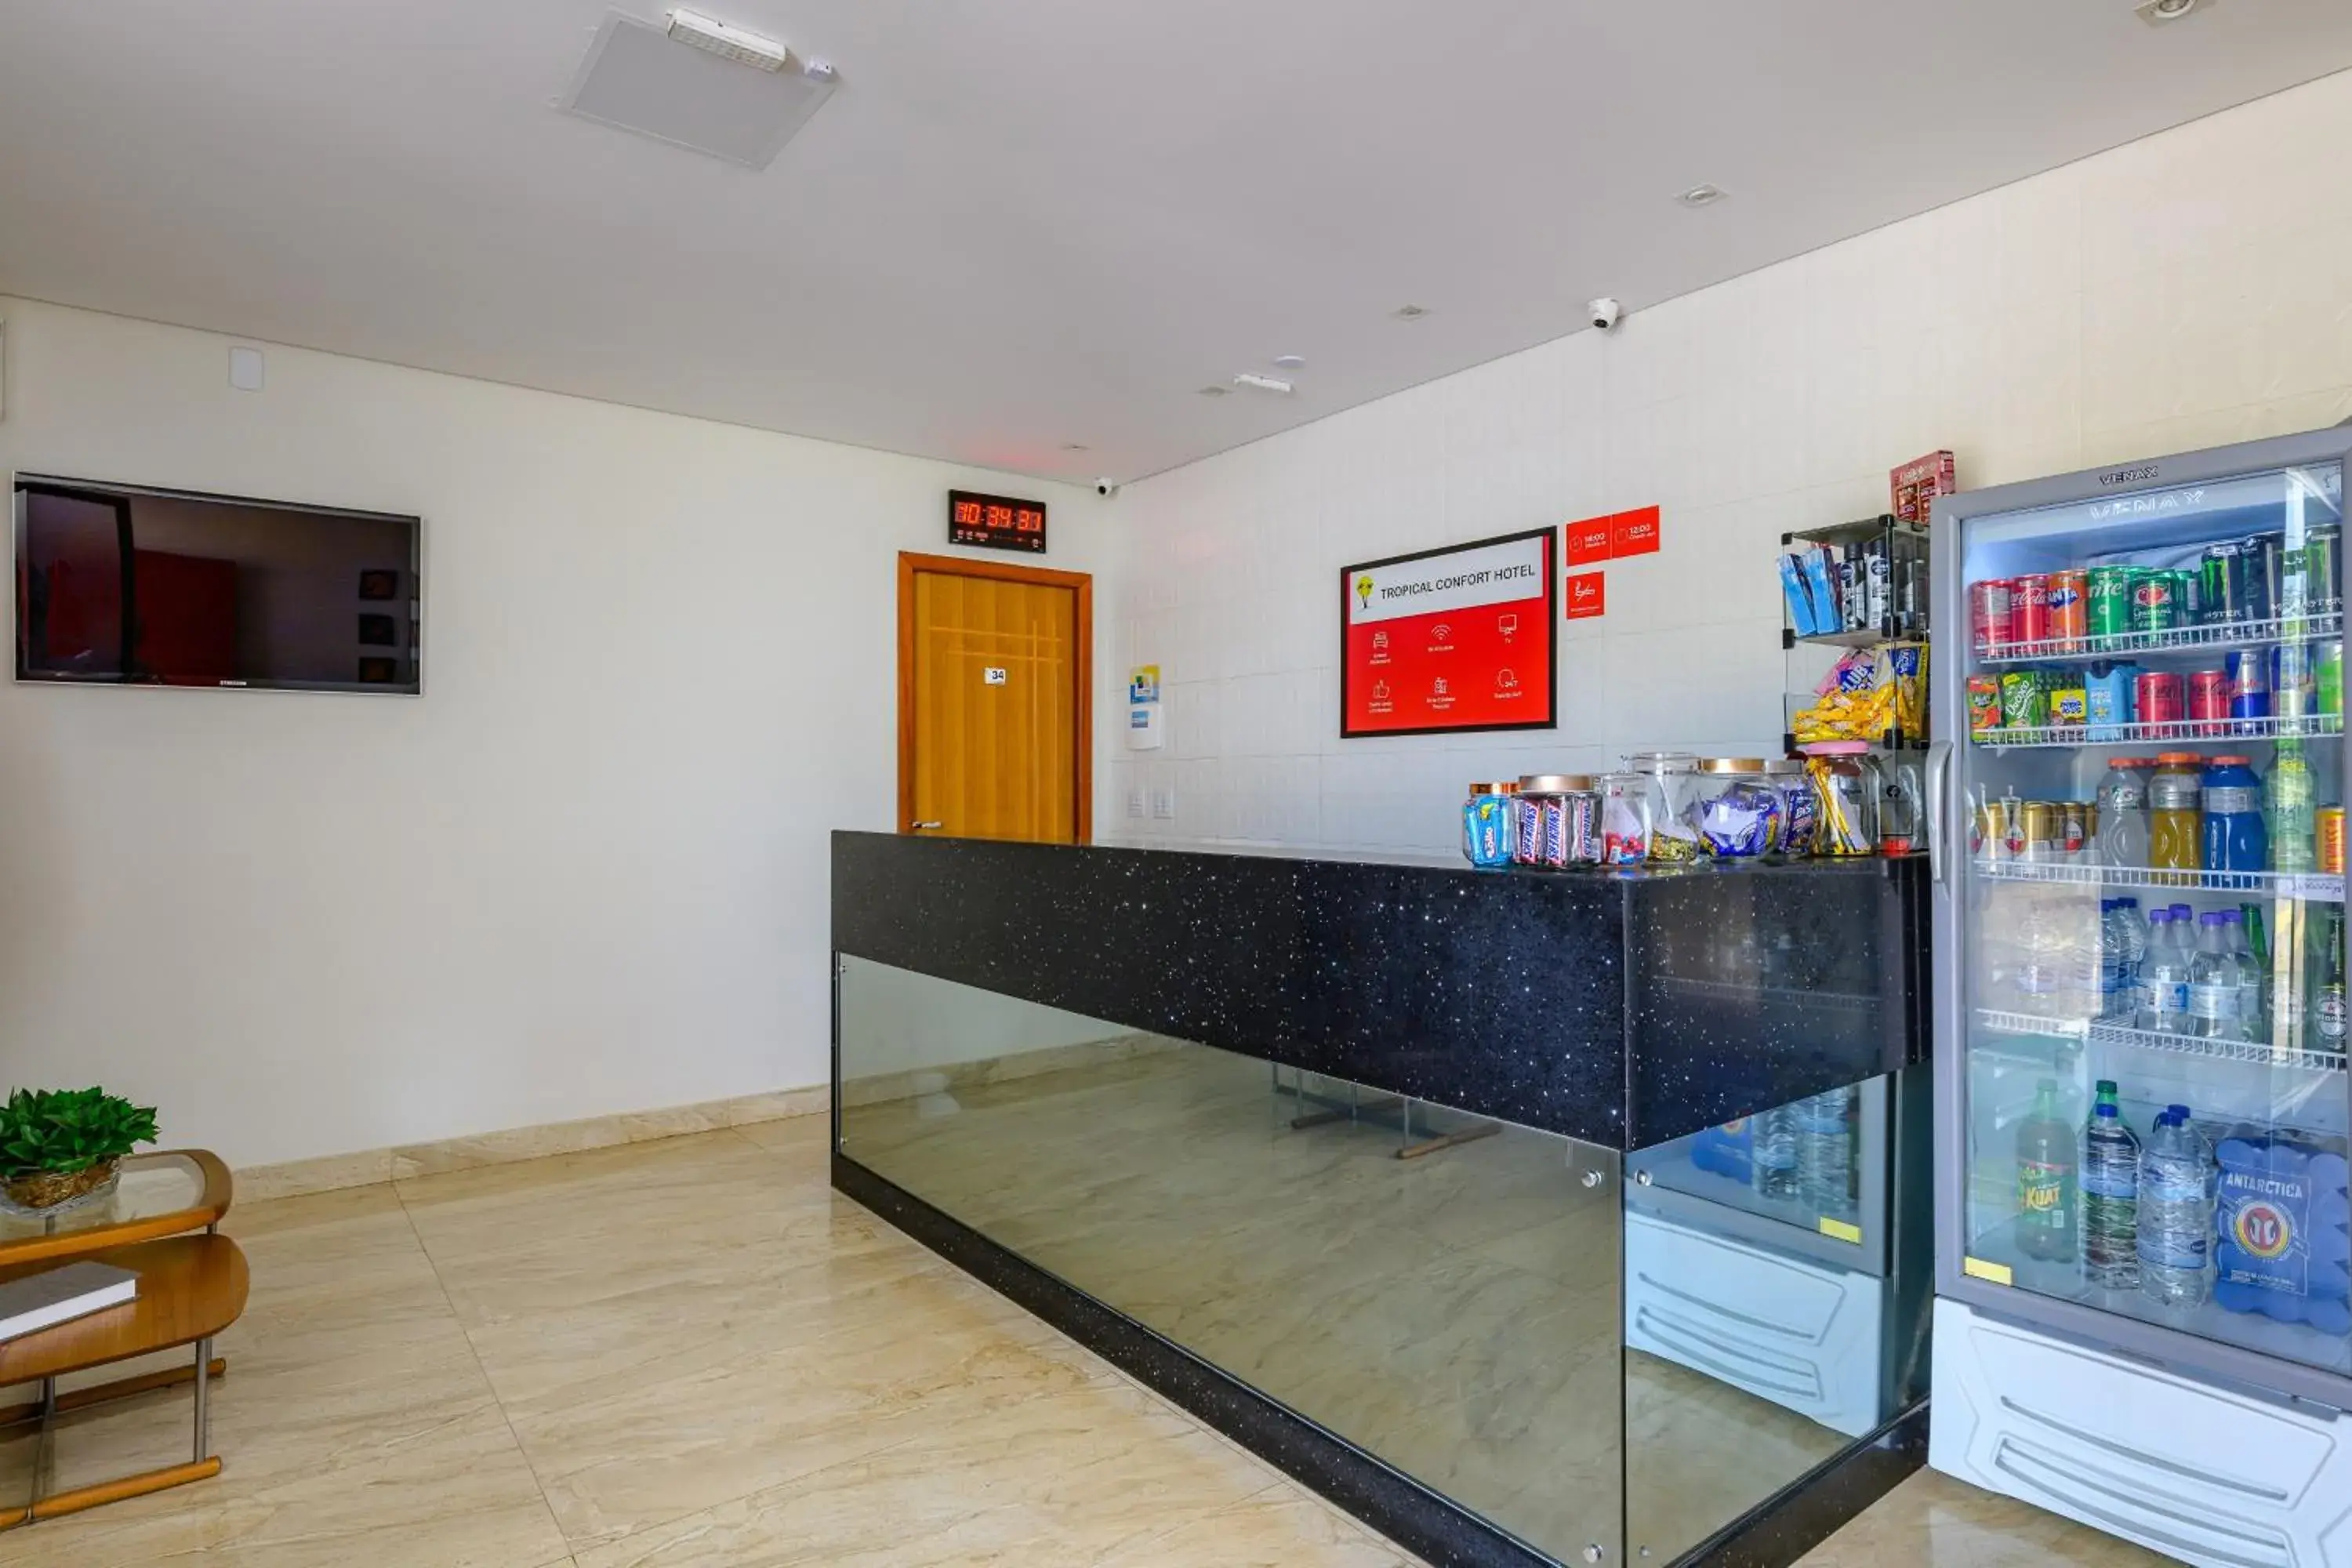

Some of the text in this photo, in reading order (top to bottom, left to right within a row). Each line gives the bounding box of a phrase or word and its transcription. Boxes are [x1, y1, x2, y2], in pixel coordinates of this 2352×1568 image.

[2099, 466, 2158, 485] VENAX
[1381, 564, 1535, 599] TROPICAL CONFORT HOTEL
[992, 670, 1004, 680] 34
[1522, 804, 1538, 858] SNICKERS
[1546, 807, 1562, 860] SNICKERS
[2025, 1186, 2060, 1208] KUAT
[2226, 1171, 2303, 1199] ANTARCTICA
